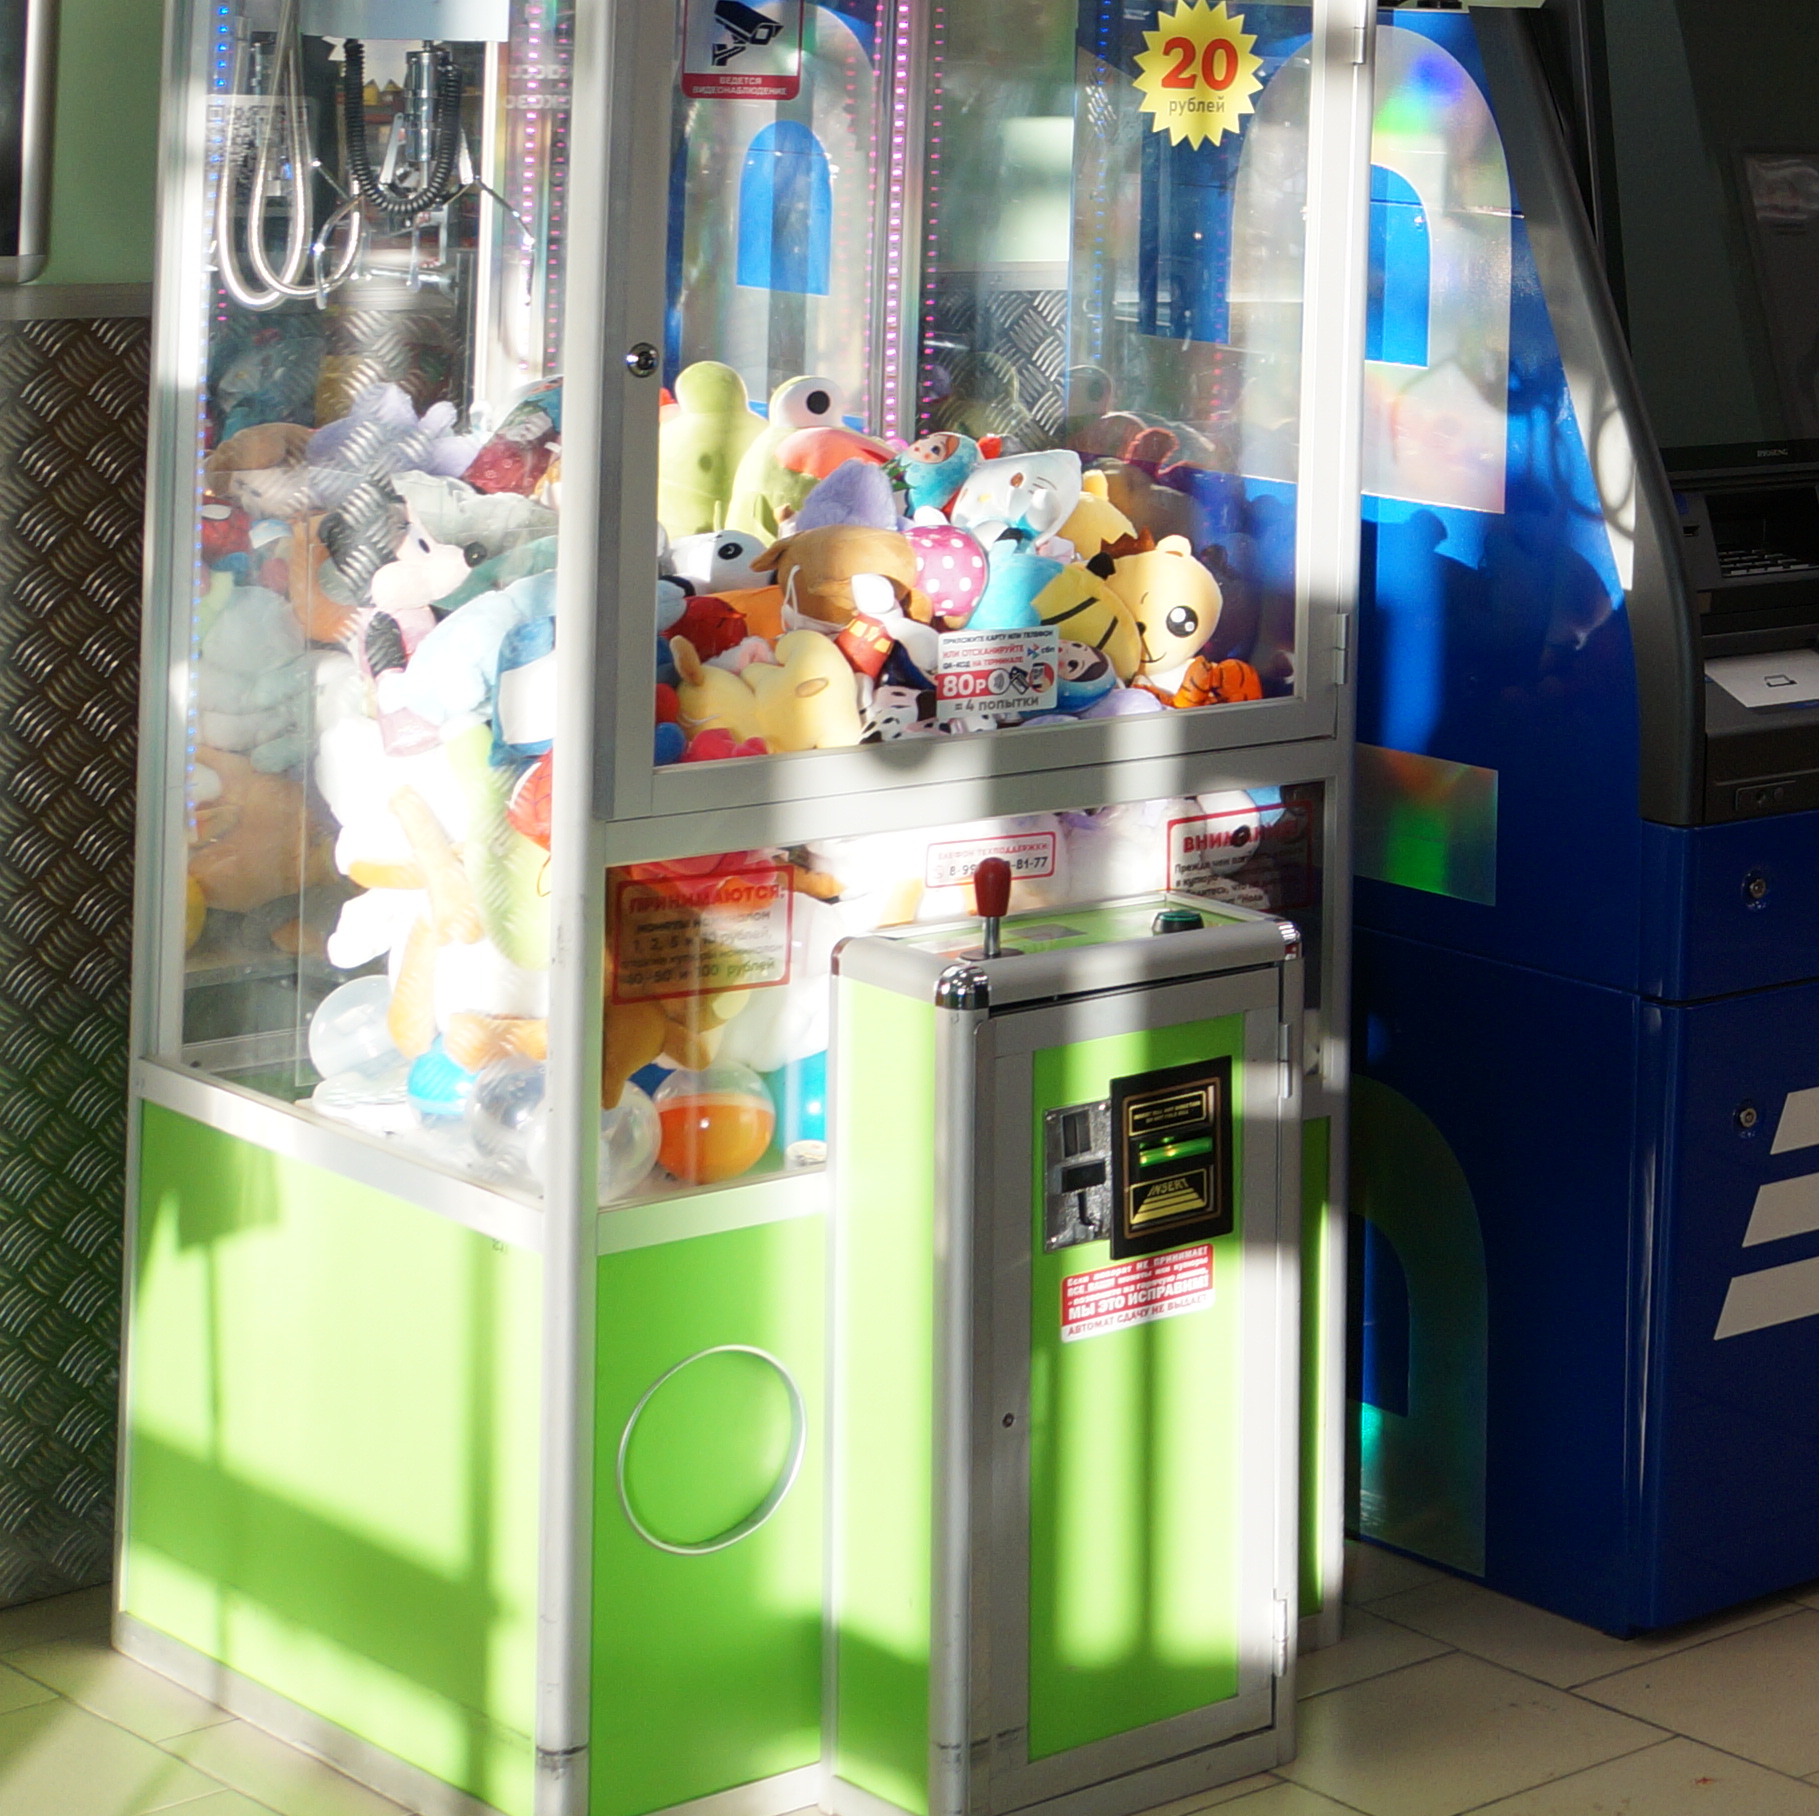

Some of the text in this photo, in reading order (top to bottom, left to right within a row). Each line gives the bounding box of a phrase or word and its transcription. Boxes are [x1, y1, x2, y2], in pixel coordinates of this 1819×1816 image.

[1160, 37, 1239, 90] 20
[692, 85, 788, 96] ВИДЕОНАБЛЮДЕНИЕ
[719, 76, 762, 86] ВЕДЕТСЯ
[1168, 96, 1225, 117] рублей
[966, 697, 1039, 711] 4 ПОПЫТКИ
[1147, 1178, 1189, 1197] INSERT
[1136, 1261, 1149, 1271] НЕ
[1153, 1246, 1208, 1266] ПРИНИМАЕТ
[1068, 1304, 1096, 1320] МЫ
[1097, 1296, 1125, 1313] ЭТО
[1068, 1316, 1114, 1336] АВТОМАТ
[1117, 1308, 1150, 1323] СДАЧУ
[1152, 1304, 1165, 1314] НЕ
